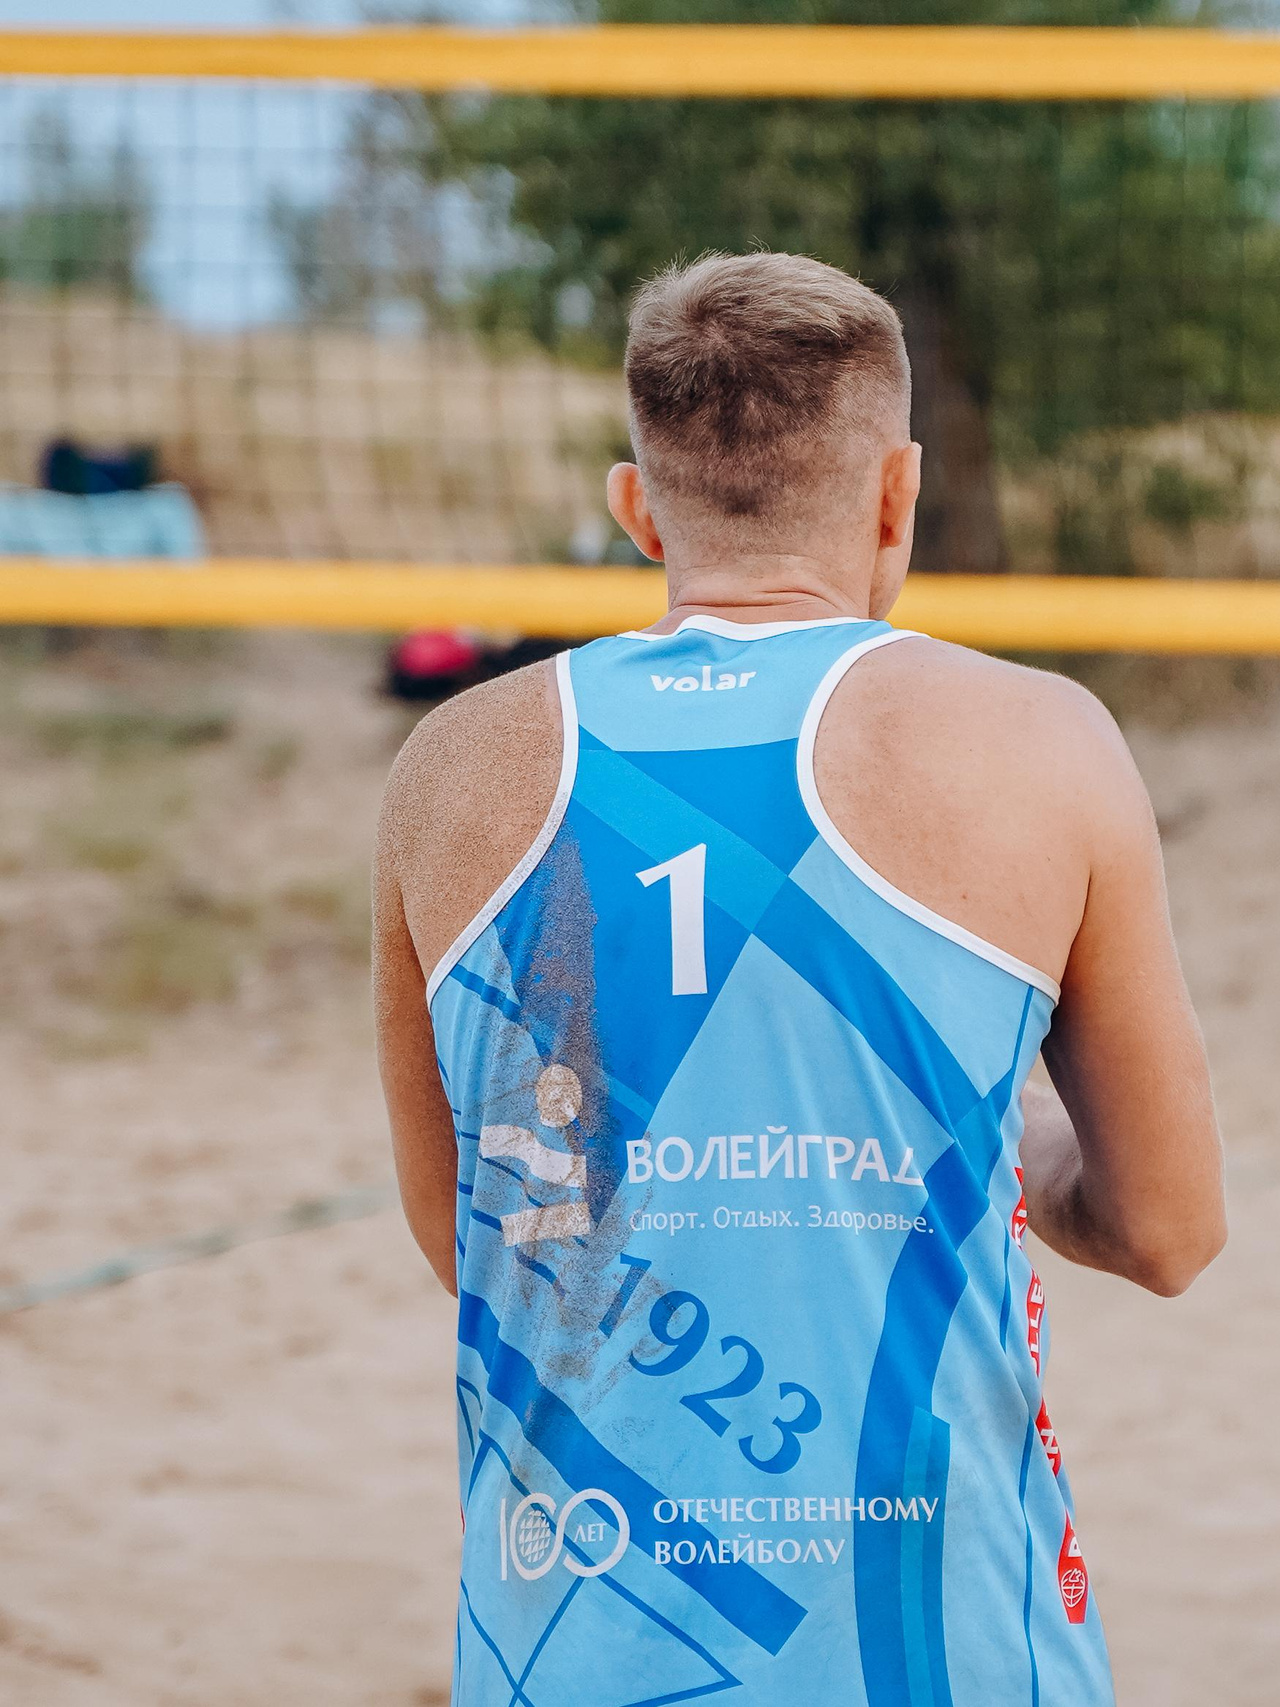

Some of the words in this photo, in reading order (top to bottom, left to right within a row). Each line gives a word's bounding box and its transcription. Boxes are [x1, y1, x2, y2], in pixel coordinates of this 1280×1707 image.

[650, 665, 757, 692] volar
[635, 843, 708, 996] 1
[713, 1205, 800, 1229] Отдых.
[807, 1204, 935, 1235] Здоровье.
[598, 1252, 822, 1475] 1923
[652, 1496, 940, 1524] ОТЕЧЕСТВЕННОМУ
[573, 1522, 608, 1543] ЛЕТ
[655, 1533, 846, 1566] ВОЛЕЙБОЛУ
